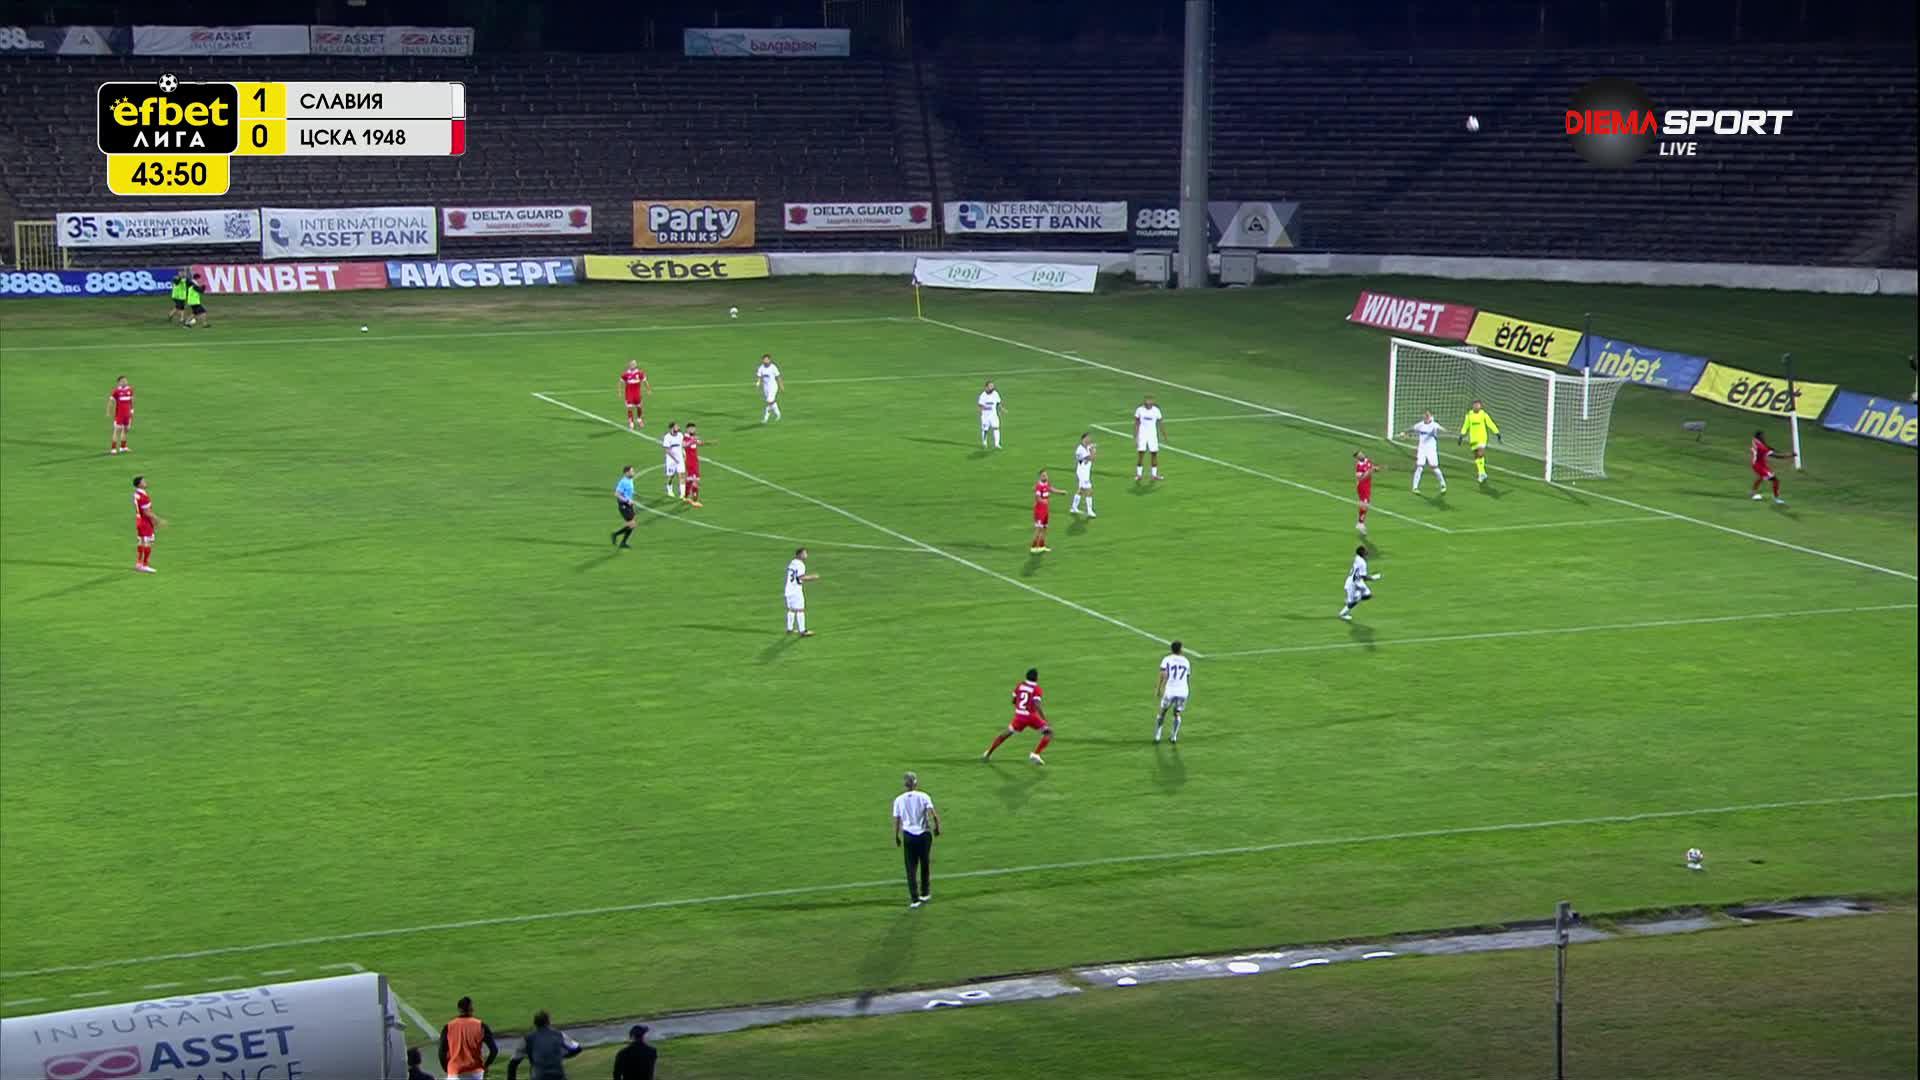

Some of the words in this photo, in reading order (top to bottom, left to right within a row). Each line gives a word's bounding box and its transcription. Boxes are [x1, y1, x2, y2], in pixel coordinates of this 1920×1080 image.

[344, 33, 384, 44] ASSET
[430, 34, 470, 44] ASSET
[472, 210, 514, 221] DELTA
[517, 209, 564, 220] GUARD
[812, 205, 854, 216] DELTA
[857, 205, 904, 216] GUARD
[985, 203, 1103, 215] INTERNATIONAL
[125, 217, 209, 228] INTERNATIONAL
[300, 216, 428, 231] INTERNATIONAL
[650, 205, 739, 238] Party
[985, 215, 1044, 229] ASSET
[1049, 215, 1103, 229] BANK
[1136, 209, 1180, 228] 888
[67, 216, 98, 239] 35
[126, 228, 168, 239] ASSET
[172, 226, 211, 237] BANK
[300, 231, 364, 247] ASSET
[371, 230, 429, 246] BANK
[658, 232, 719, 242] DRINKS
[400, 261, 561, 288] АИСБЕРГ
[630, 259, 729, 279] efbet
[204, 265, 340, 294] WINBET
[1360, 294, 1445, 334] WINBET
[1494, 321, 1554, 358] efbet
[1593, 341, 1662, 383] inbet
[1726, 377, 1802, 413] efbet
[1170, 664, 1187, 680] 17
[1019, 692, 1029, 709] 2
[33, 998, 289, 1045] INSURANCE
[148, 1025, 295, 1073] ASSET
